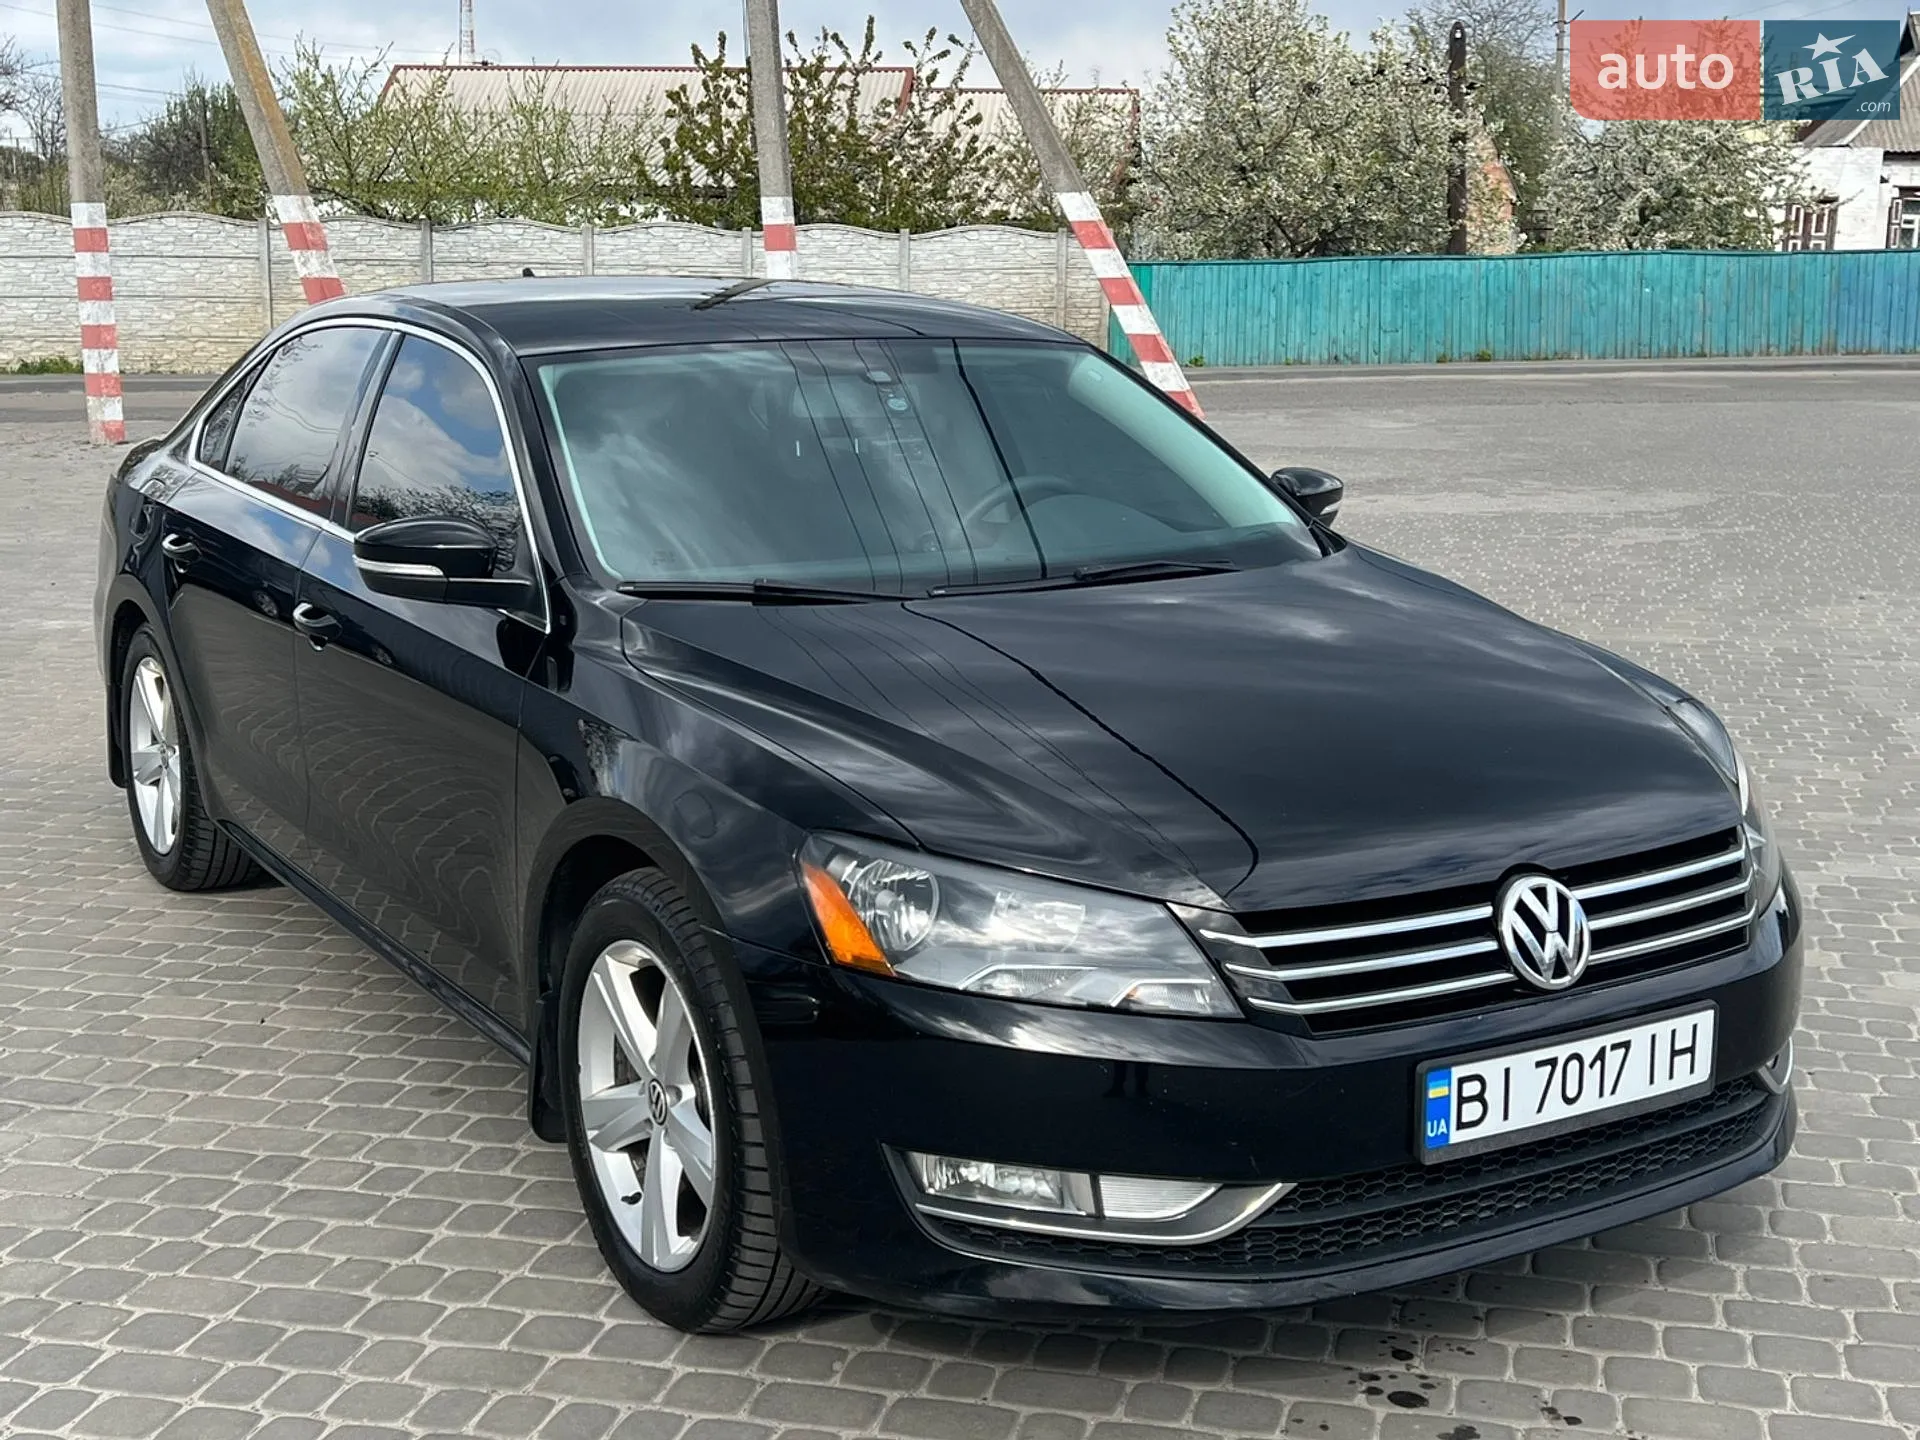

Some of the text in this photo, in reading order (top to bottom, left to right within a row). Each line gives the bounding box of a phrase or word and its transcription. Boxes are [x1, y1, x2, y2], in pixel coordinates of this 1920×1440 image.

[1455, 1023, 1698, 1131] BI 7017 IH
[1427, 1118, 1448, 1137] UA
